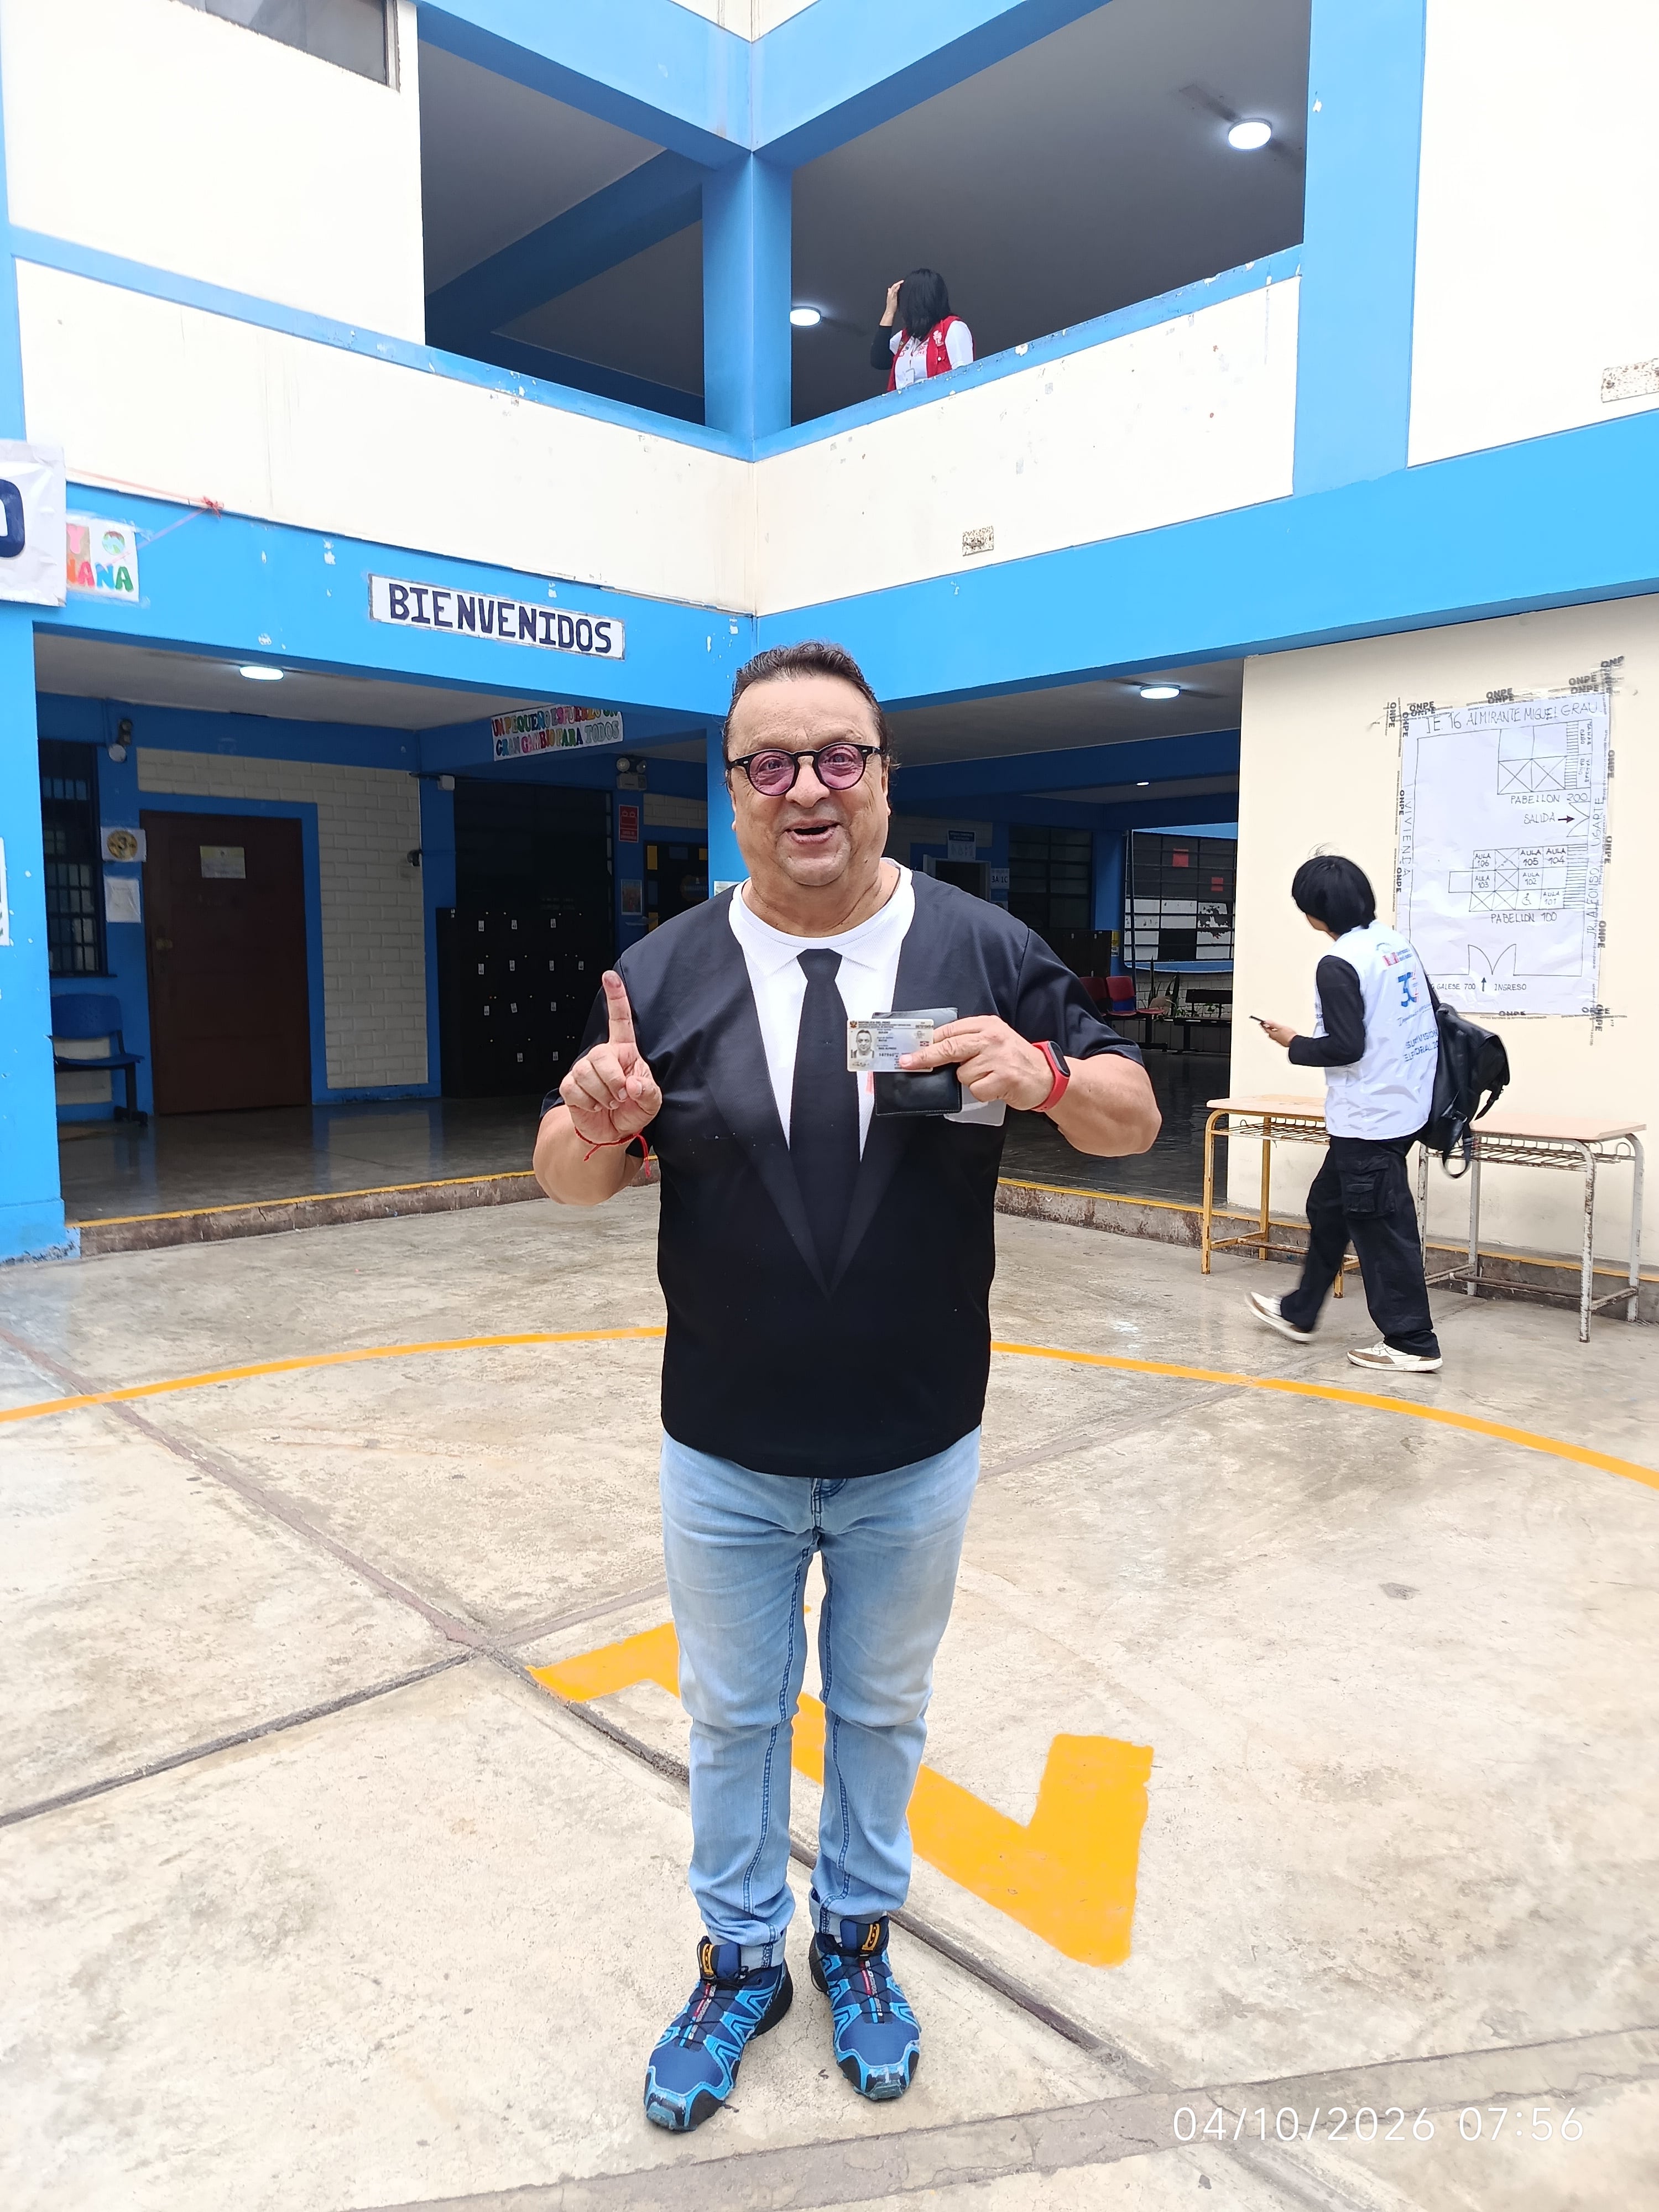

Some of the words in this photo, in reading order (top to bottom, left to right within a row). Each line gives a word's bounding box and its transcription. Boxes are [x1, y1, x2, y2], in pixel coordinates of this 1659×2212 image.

[388, 583, 612, 654] BIENVENIDOS
[1568, 675, 1597, 686] ONPE
[1486, 688, 1513, 699] ONPE
[1388, 702, 1397, 728] ONPE
[1410, 701, 1434, 712] ONPE
[1448, 711, 1462, 729] 16
[1466, 707, 1521, 726] ALMIRANTE
[555, 727, 584, 747] PARA
[584, 720, 620, 744] TODOS
[1511, 795, 1561, 804] PABELLON
[1567, 792, 1588, 802] 200
[1524, 812, 1556, 824] SALIDA
[1590, 797, 1604, 847] UGARTE
[1604, 836, 1613, 864] ONPE
[1586, 868, 1599, 918] ALFONSO
[1491, 913, 1536, 924] PABELLON
[1541, 912, 1557, 922] 100
[1598, 920, 1607, 948] ONPE
